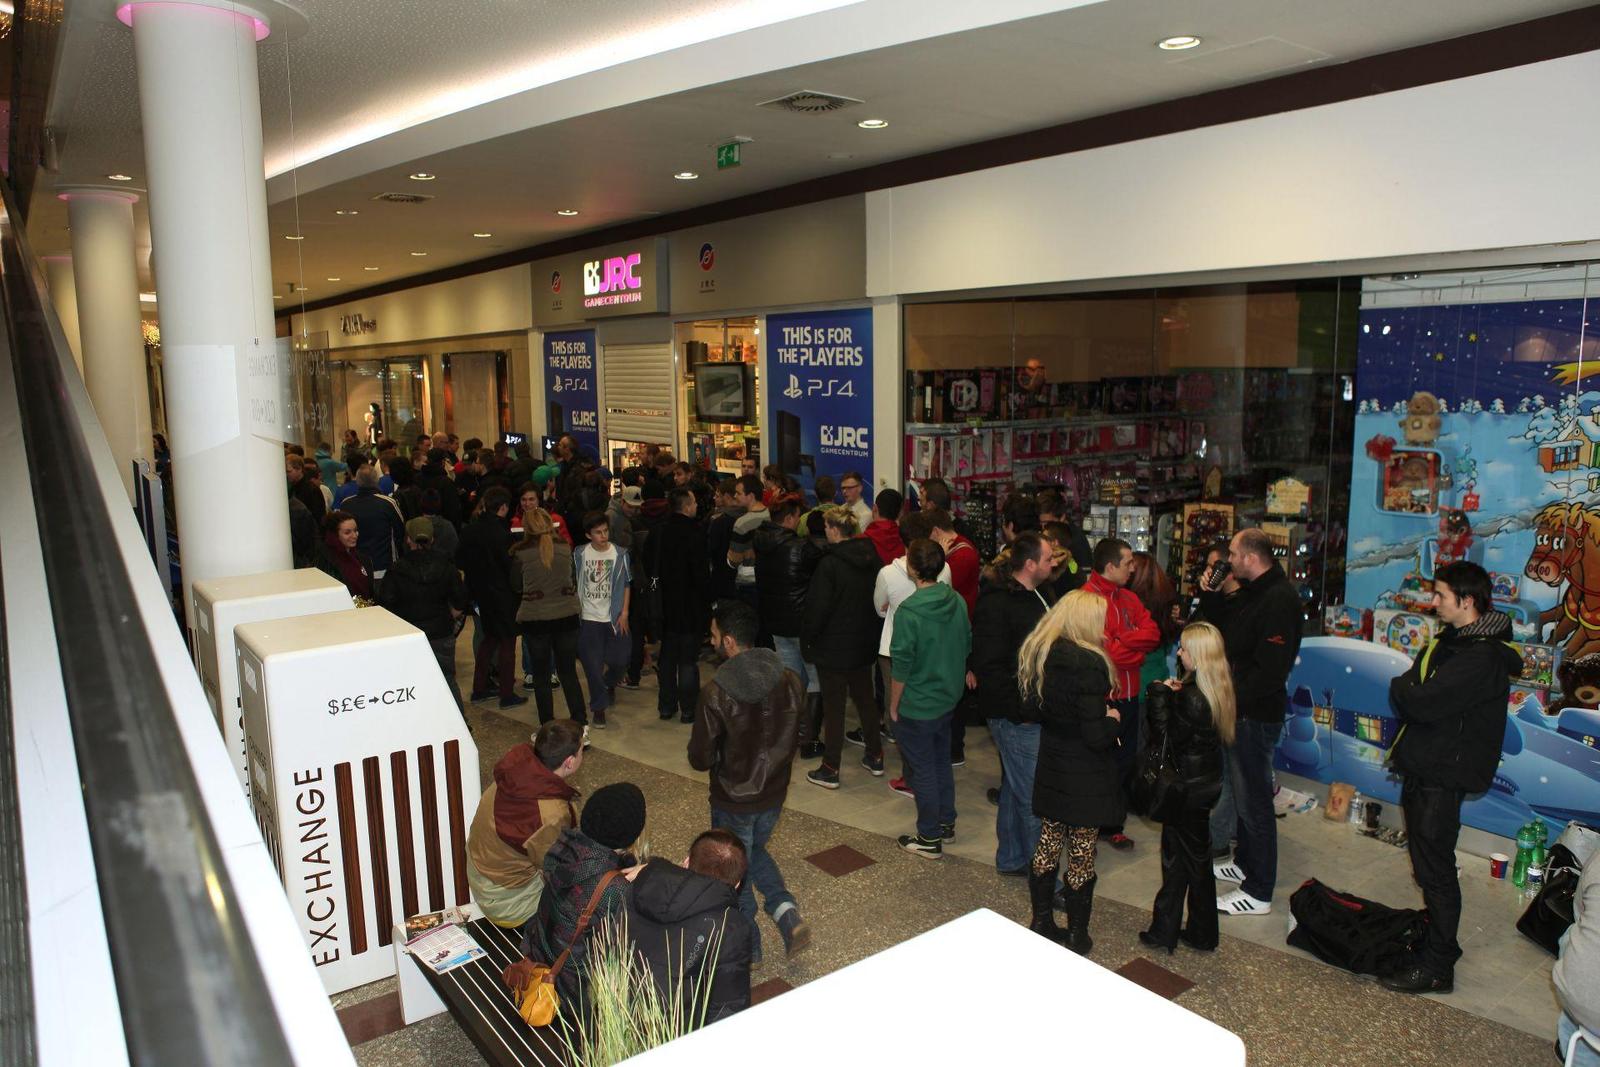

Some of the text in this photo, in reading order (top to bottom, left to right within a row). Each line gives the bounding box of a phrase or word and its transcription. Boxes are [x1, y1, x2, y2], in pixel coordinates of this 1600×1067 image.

[584, 292, 642, 308] GAMECENTRUM
[782, 326, 852, 346] THIS IS FOR
[551, 340, 586, 355] THIS IS FOR
[549, 355, 592, 370] THE PLAYERS
[777, 346, 863, 367] THE PLAYERS
[564, 378, 588, 391] PS4
[807, 379, 855, 397] PS4
[820, 447, 869, 457] GAMECENTRUM
[382, 686, 416, 705] CZK
[293, 767, 340, 968] EXCHANGE
